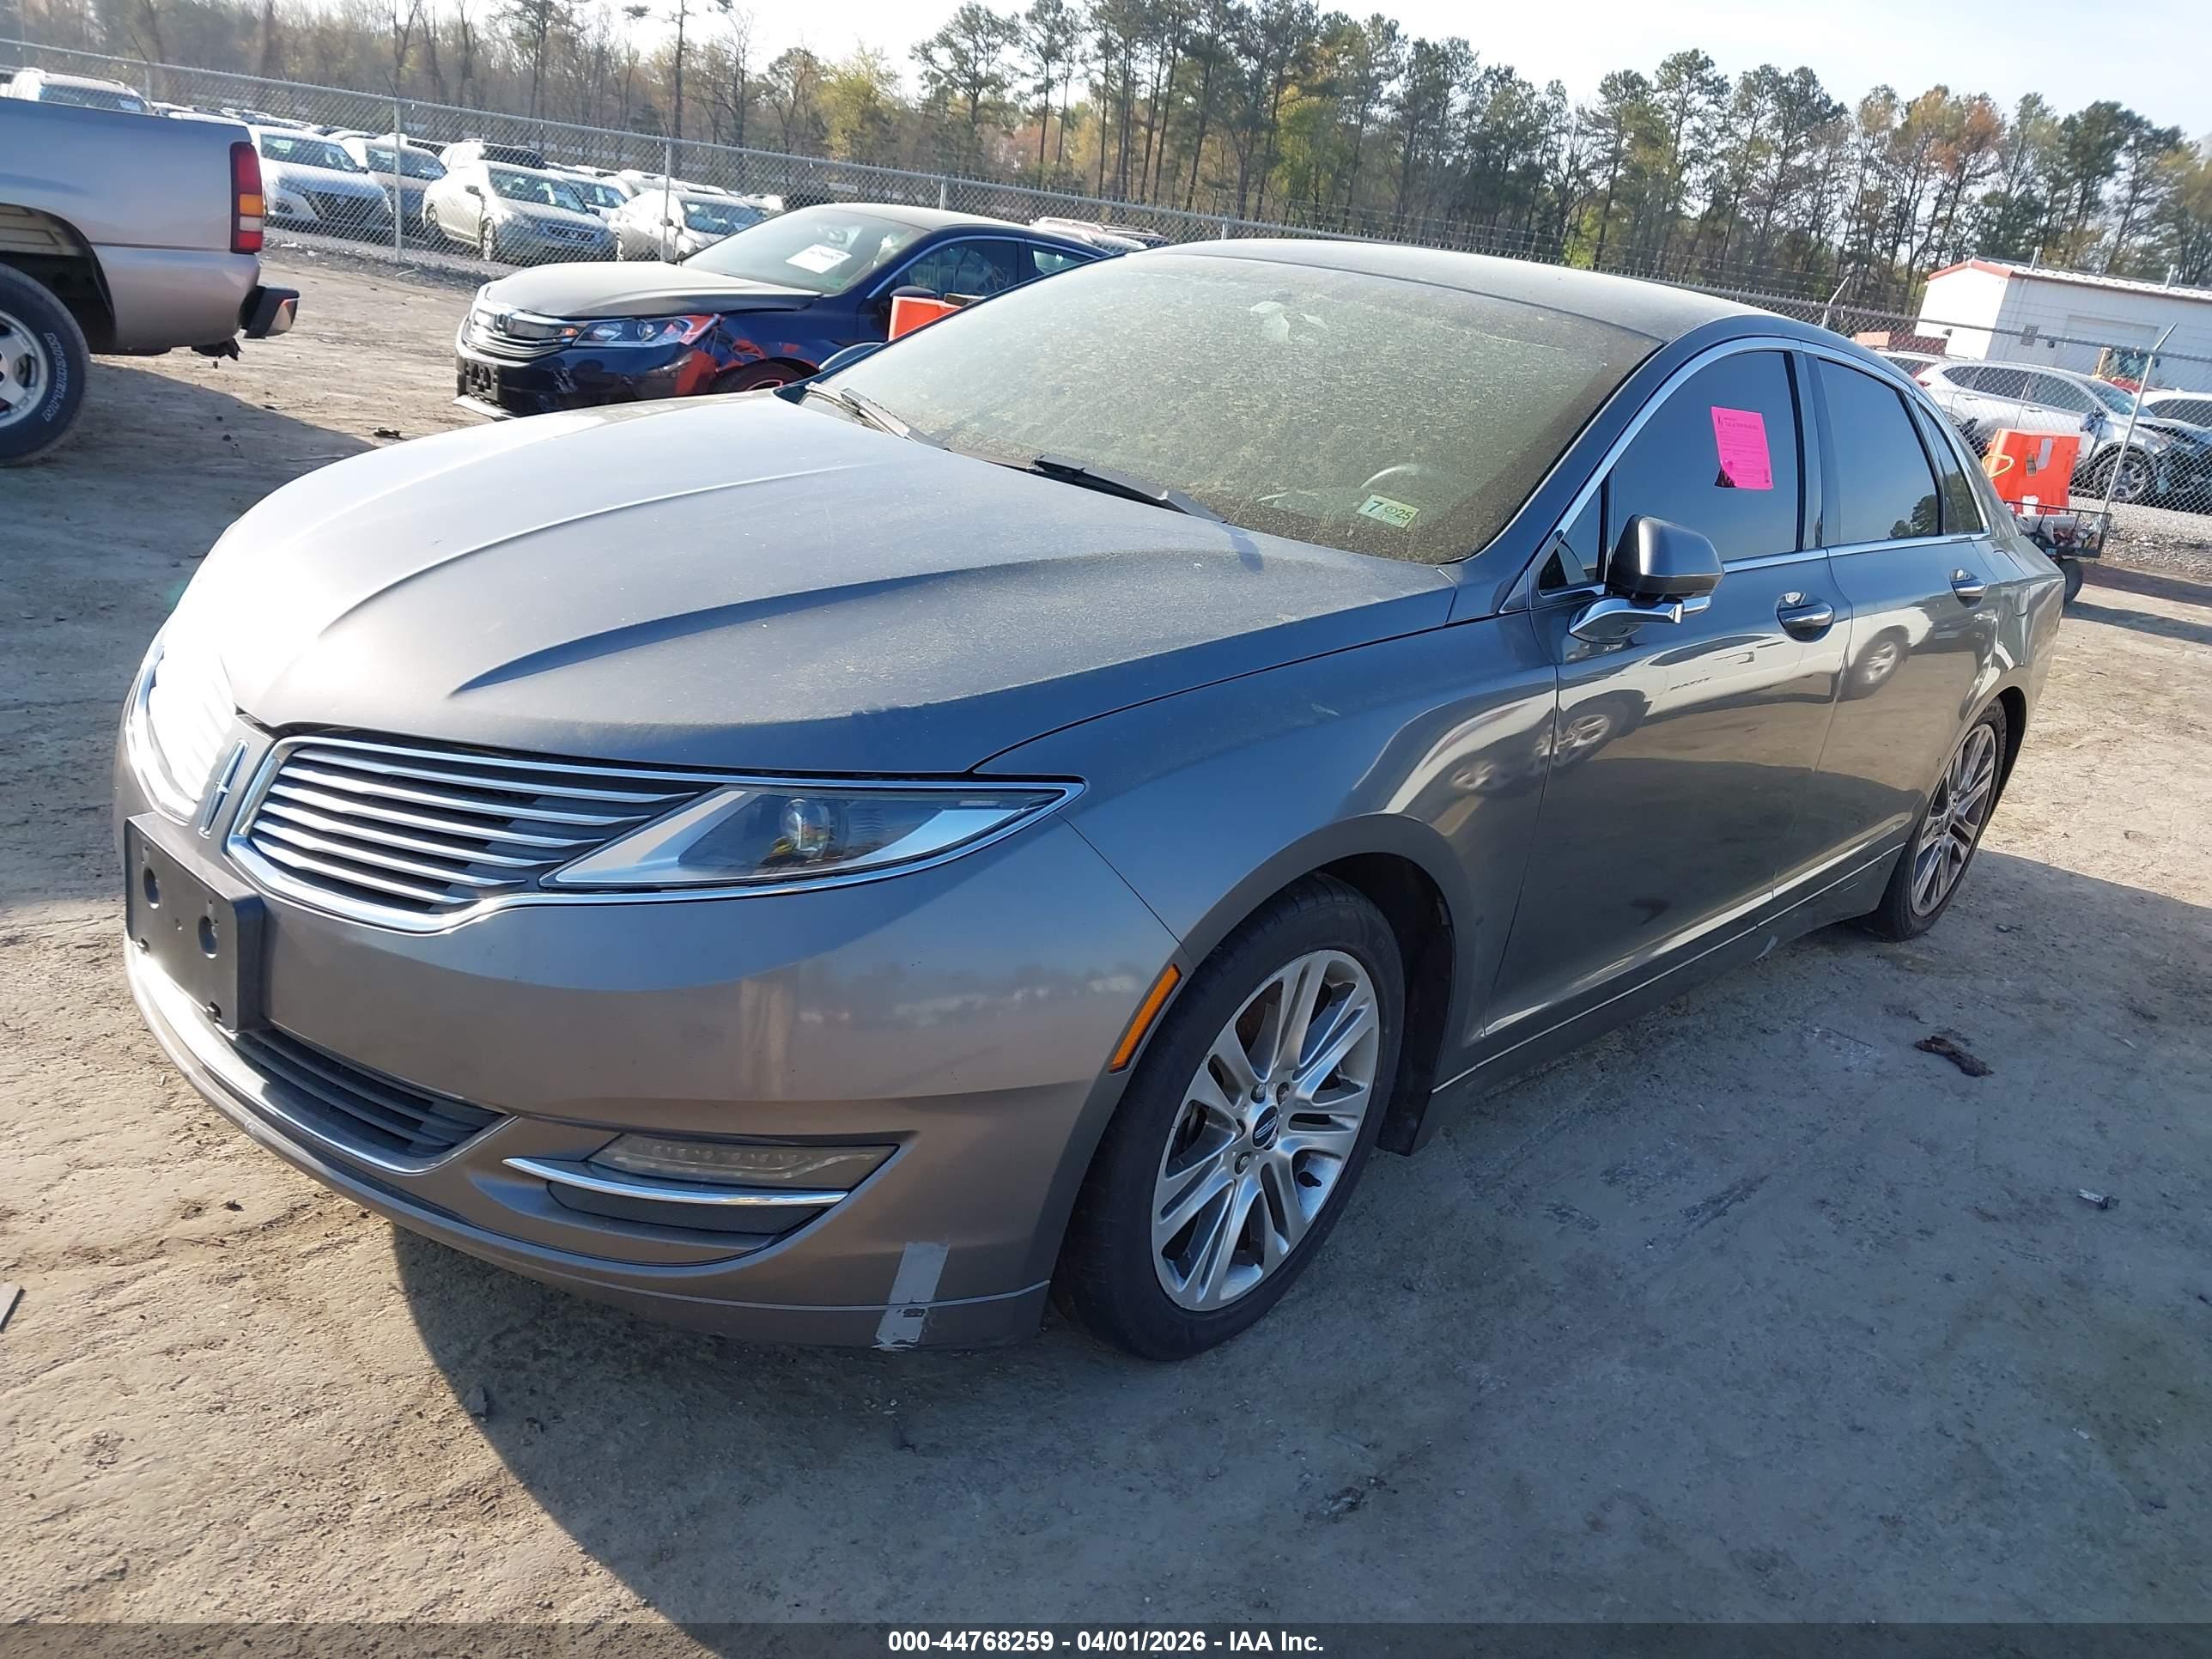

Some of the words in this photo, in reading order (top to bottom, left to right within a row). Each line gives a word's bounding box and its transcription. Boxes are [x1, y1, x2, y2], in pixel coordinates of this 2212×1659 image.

[41, 332, 68, 422] MICHELIN
[1368, 501, 1383, 513] 7
[1395, 509, 1413, 520] 25
